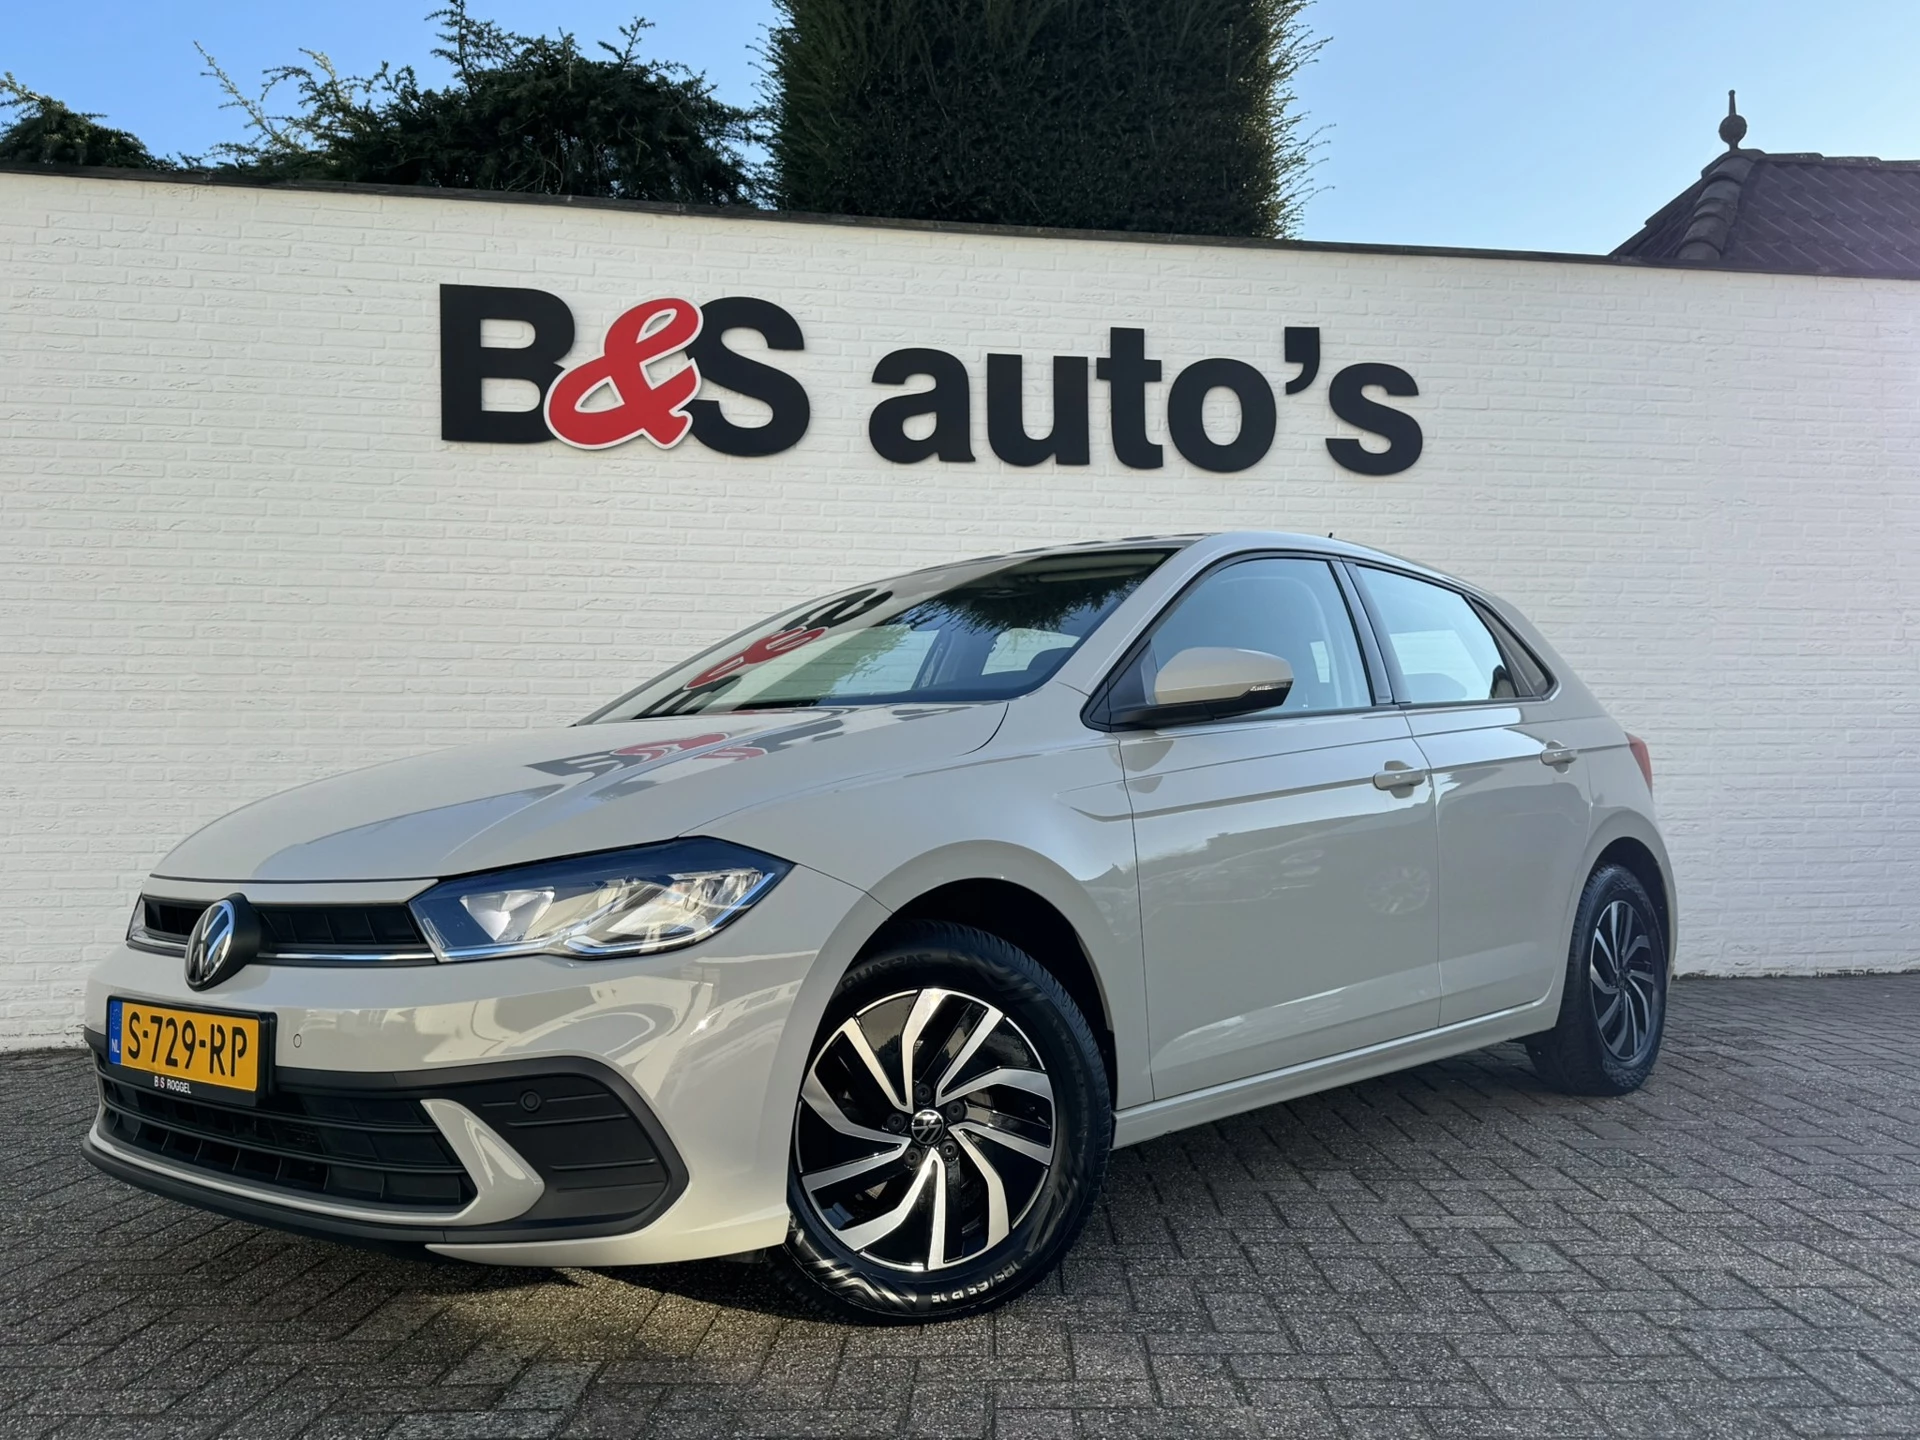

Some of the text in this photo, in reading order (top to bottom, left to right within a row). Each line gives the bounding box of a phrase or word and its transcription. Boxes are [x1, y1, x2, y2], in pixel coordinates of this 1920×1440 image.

[440, 284, 1423, 476] B&S auto's
[111, 1038, 120, 1053] NL
[127, 1011, 248, 1077] S-729-RP
[167, 1079, 191, 1094] ROGGEL
